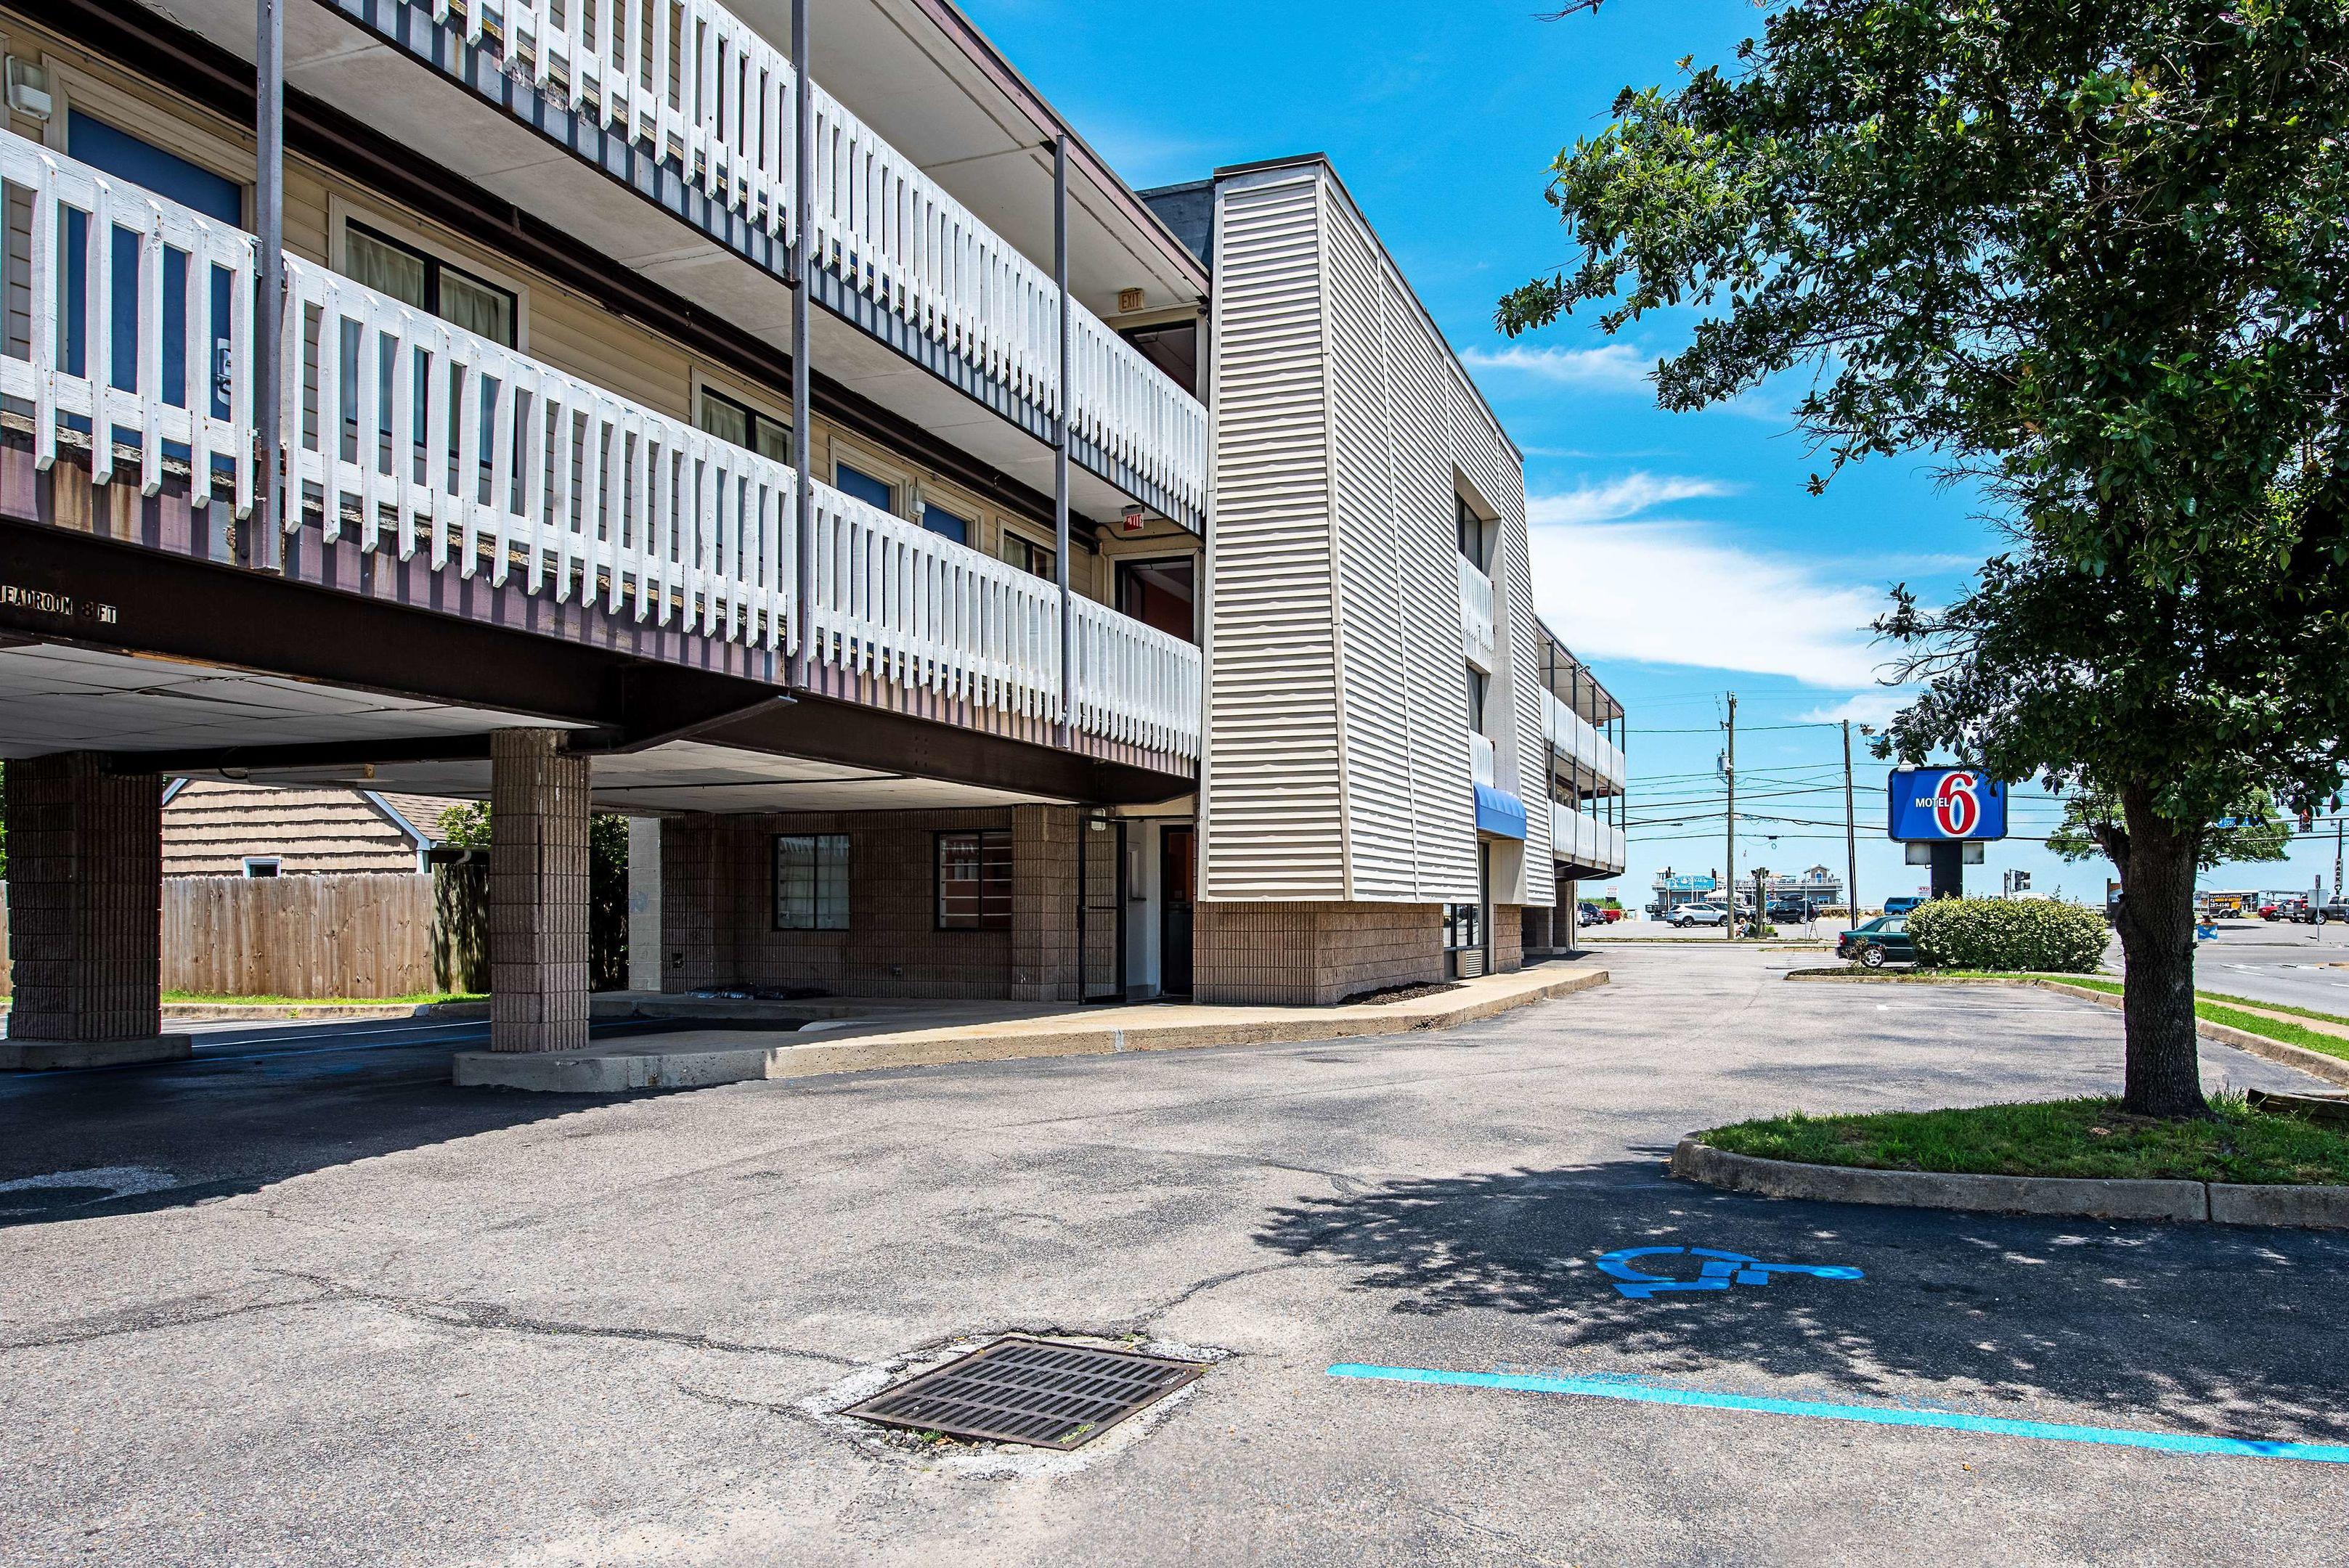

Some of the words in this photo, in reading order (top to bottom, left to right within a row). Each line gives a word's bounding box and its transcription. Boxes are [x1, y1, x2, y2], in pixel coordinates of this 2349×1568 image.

[1122, 292, 1140, 309] EXIT
[1125, 514, 1141, 528] EXIT
[0, 585, 73, 616] EADROOM
[82, 601, 94, 618] 8
[98, 604, 117, 624] FT
[1916, 798, 1950, 808] MOTEL
[1937, 773, 1977, 836] 6
